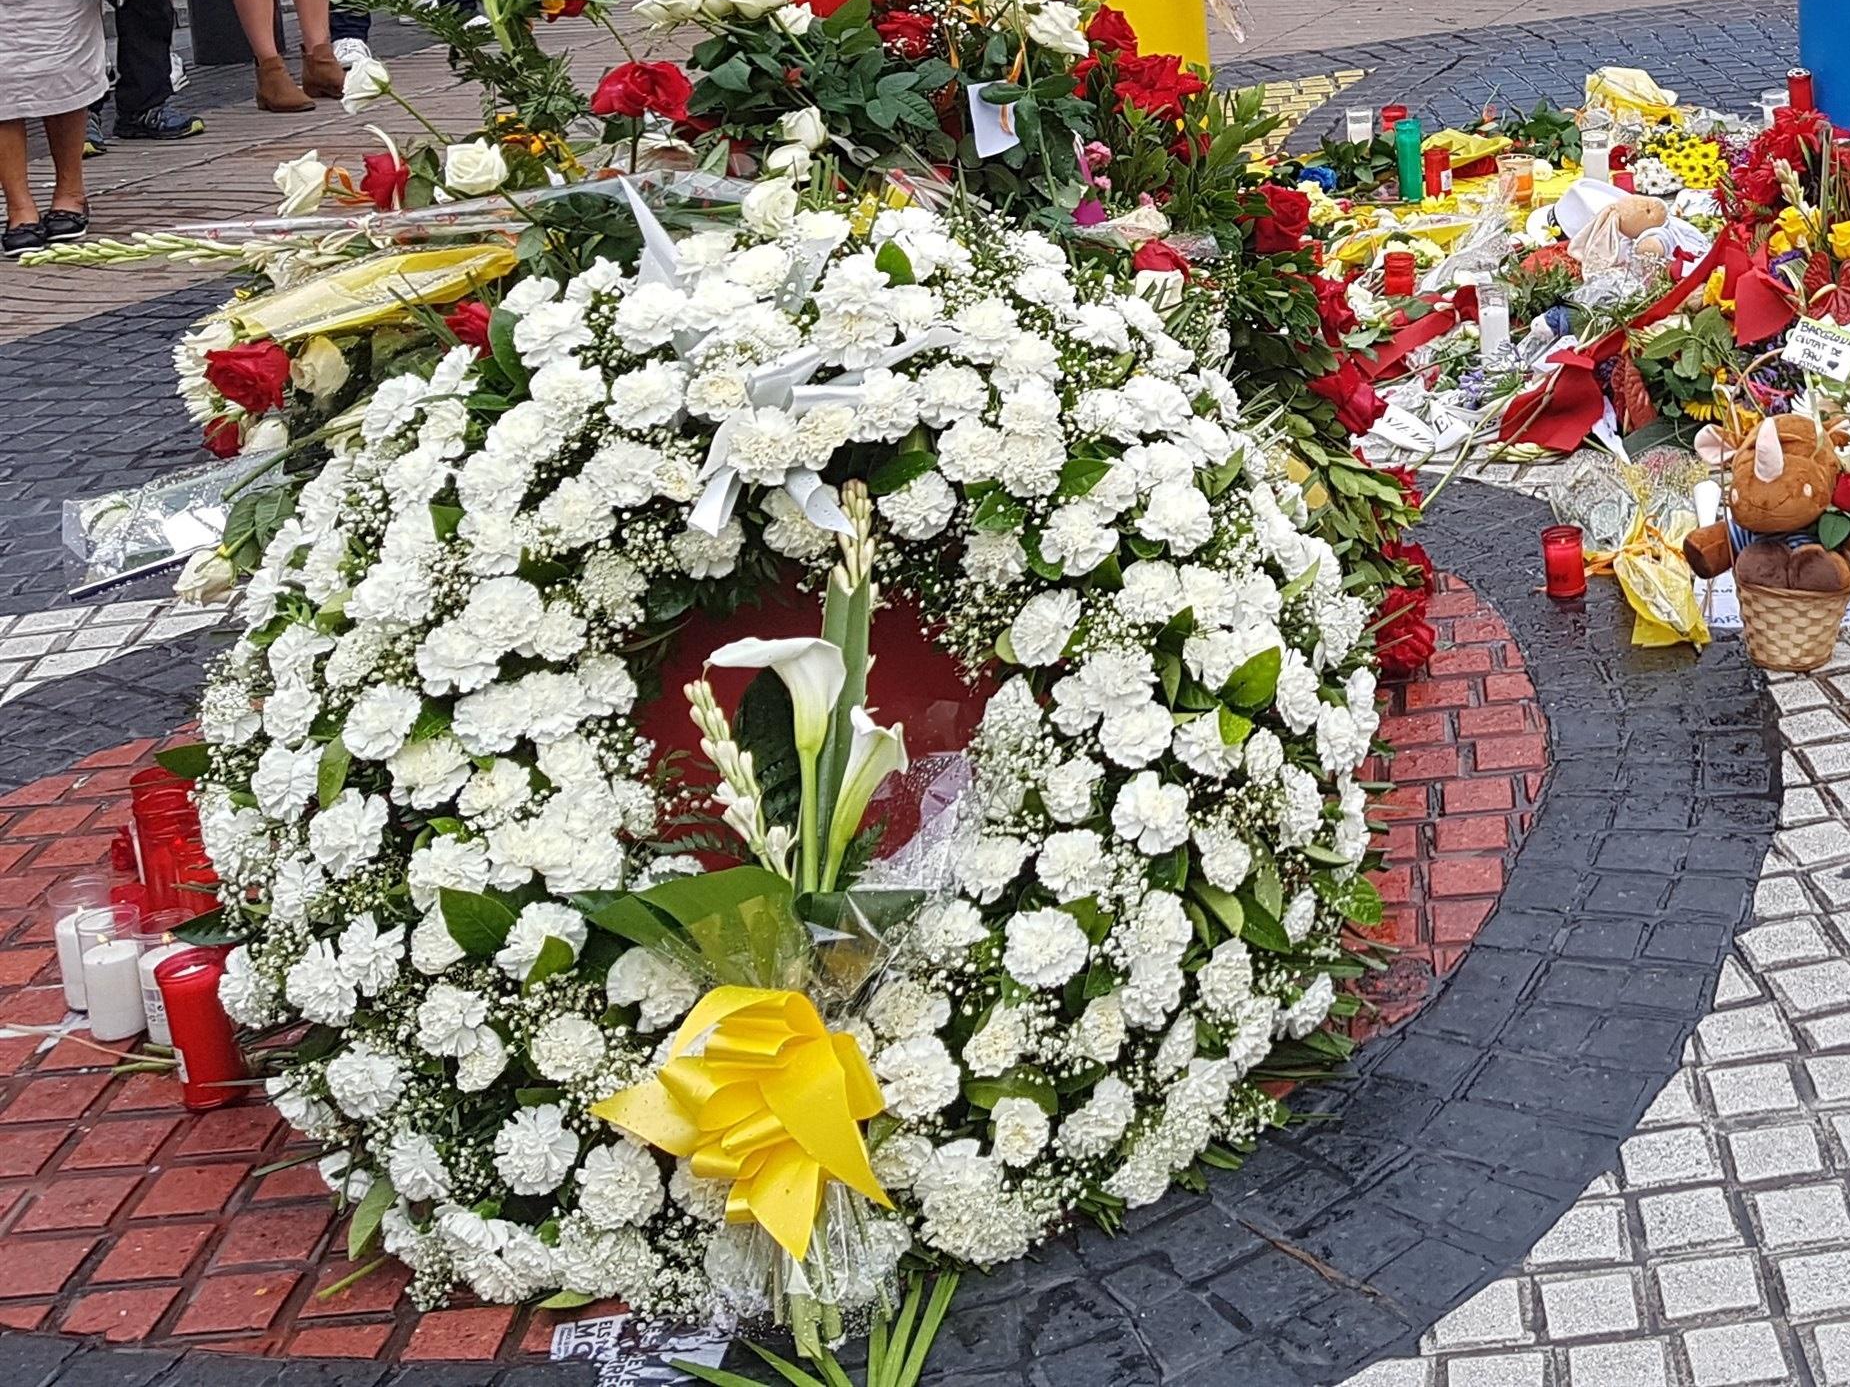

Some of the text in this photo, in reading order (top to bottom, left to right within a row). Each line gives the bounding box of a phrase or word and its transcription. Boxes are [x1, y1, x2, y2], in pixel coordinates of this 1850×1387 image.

[1795, 335, 1843, 357] CIUTAT DE
[1802, 348, 1823, 362] PAU
